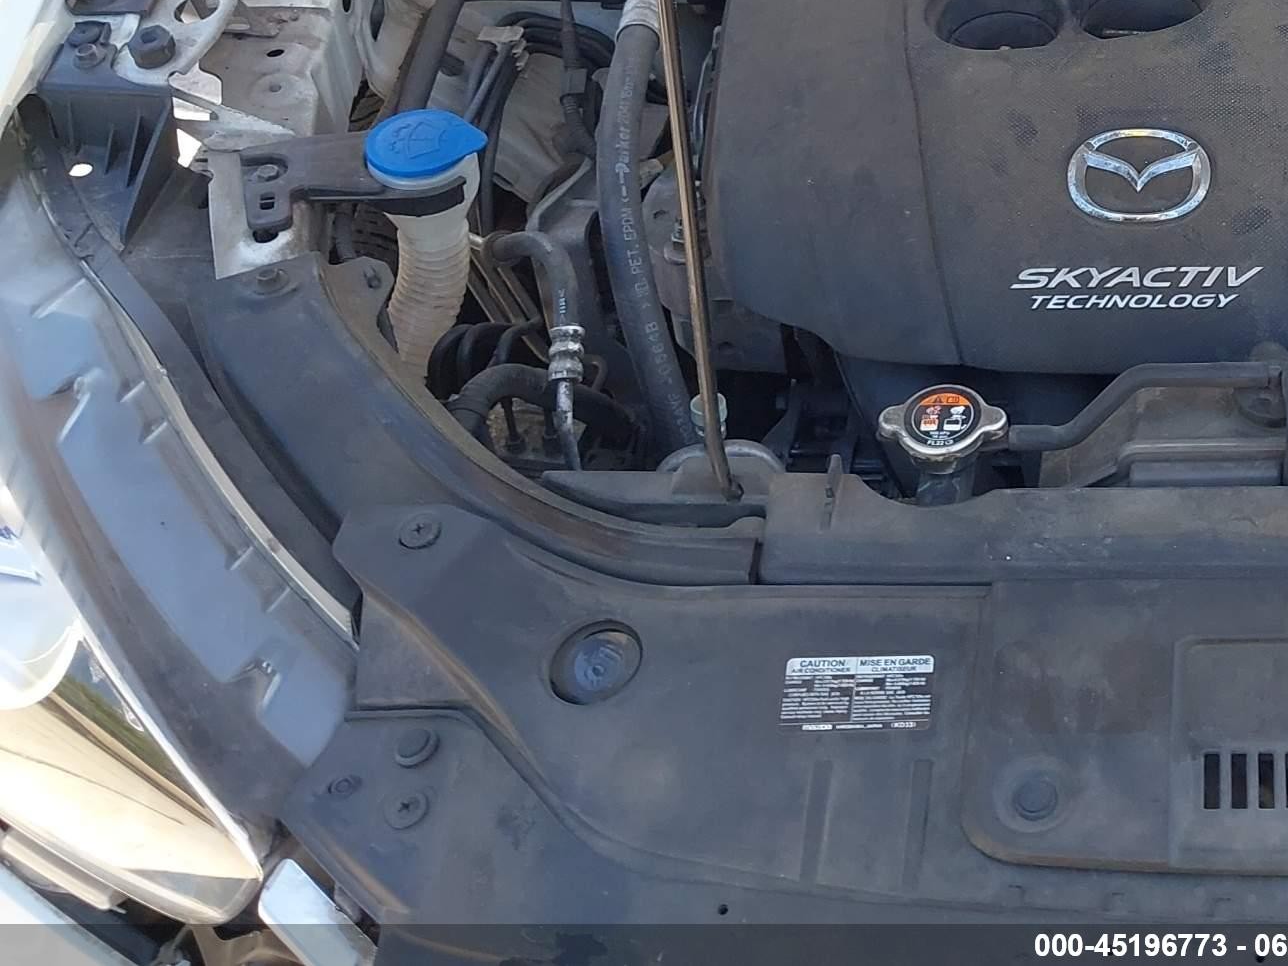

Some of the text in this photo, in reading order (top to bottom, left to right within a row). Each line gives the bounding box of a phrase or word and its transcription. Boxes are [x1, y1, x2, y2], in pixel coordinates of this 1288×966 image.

[1009, 266, 1264, 289] SKYACTIV
[1030, 293, 1242, 310] TECHNOLOGY
[799, 659, 846, 668] CAUTION
[859, 659, 885, 667] MISE
[898, 657, 931, 666] GARDE
